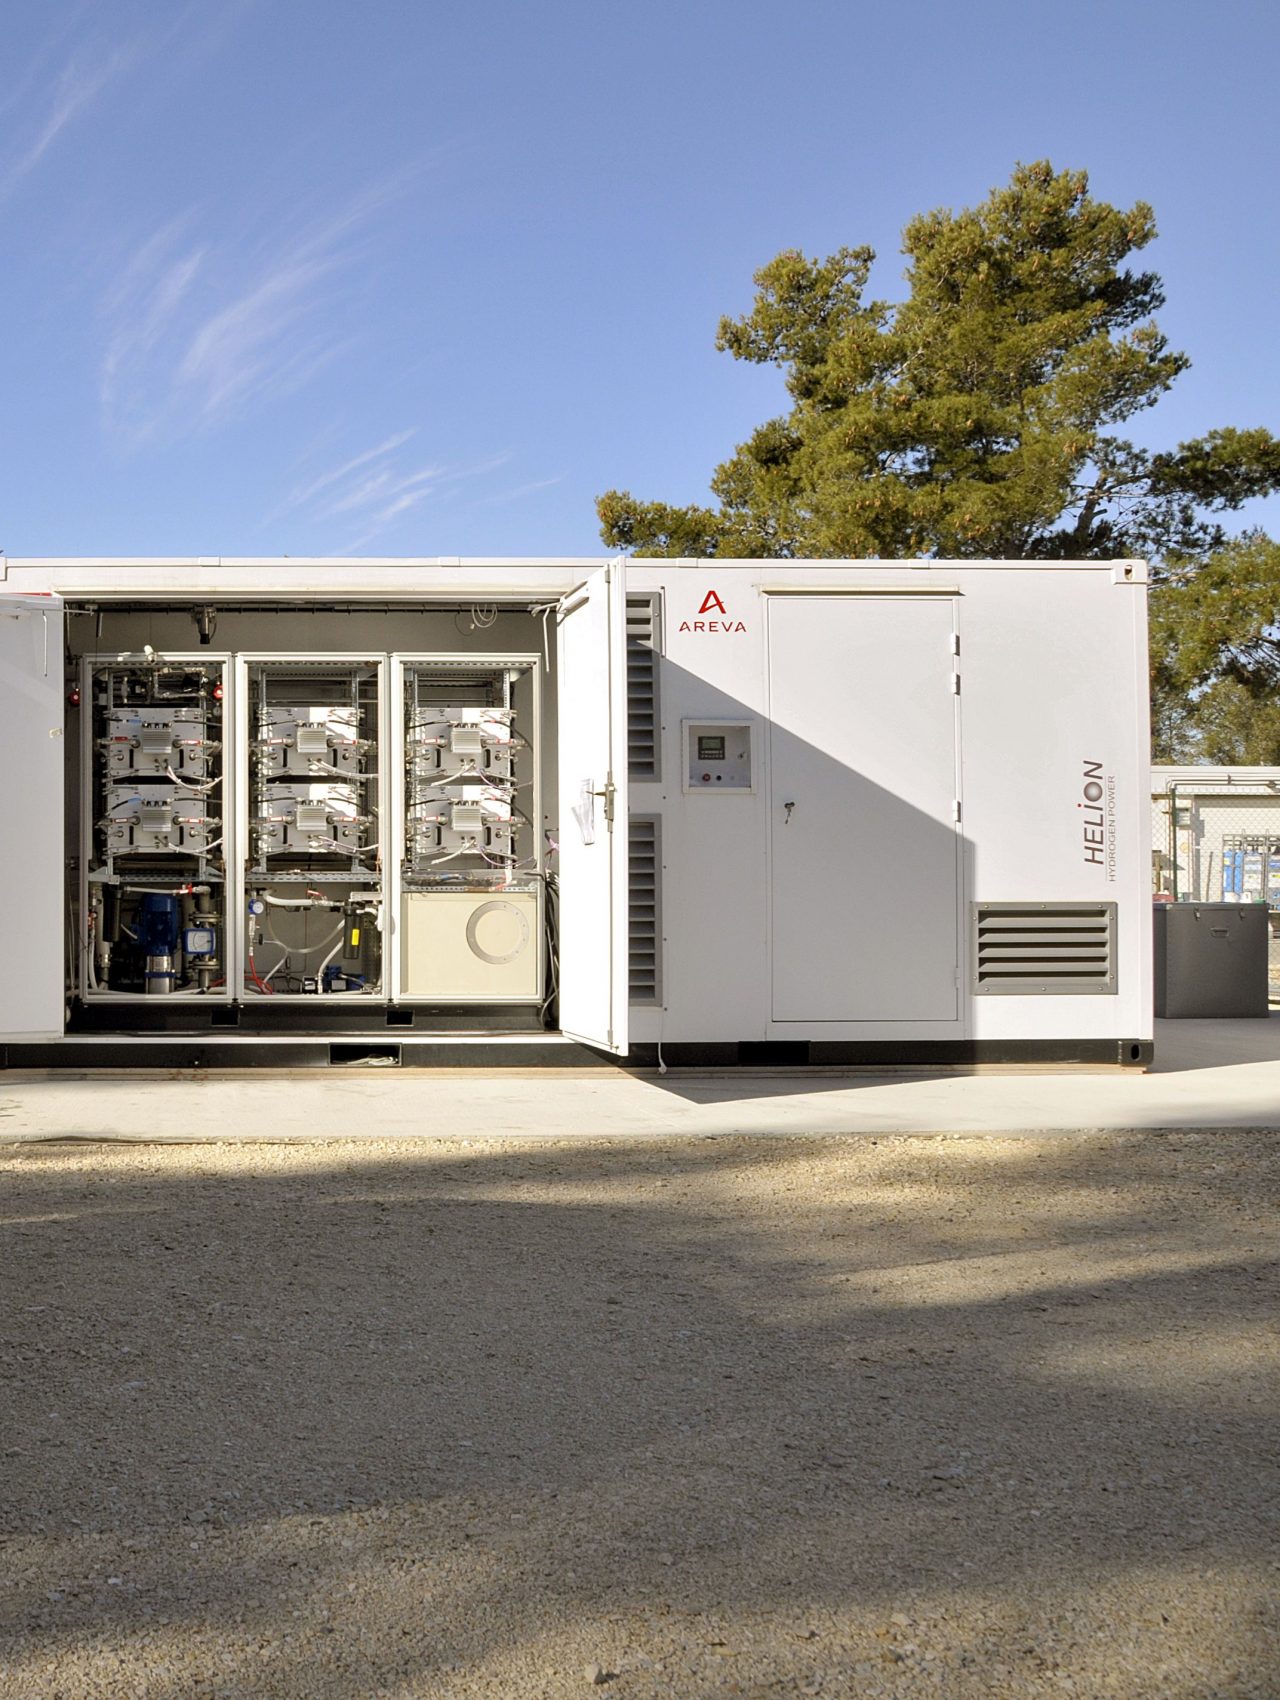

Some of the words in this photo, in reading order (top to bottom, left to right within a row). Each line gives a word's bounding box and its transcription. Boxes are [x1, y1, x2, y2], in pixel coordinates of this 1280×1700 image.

[698, 590, 727, 614] A
[678, 621, 747, 633] AREVA
[1108, 775, 1116, 817] POWER
[1108, 819, 1116, 882] HYDROGEN
